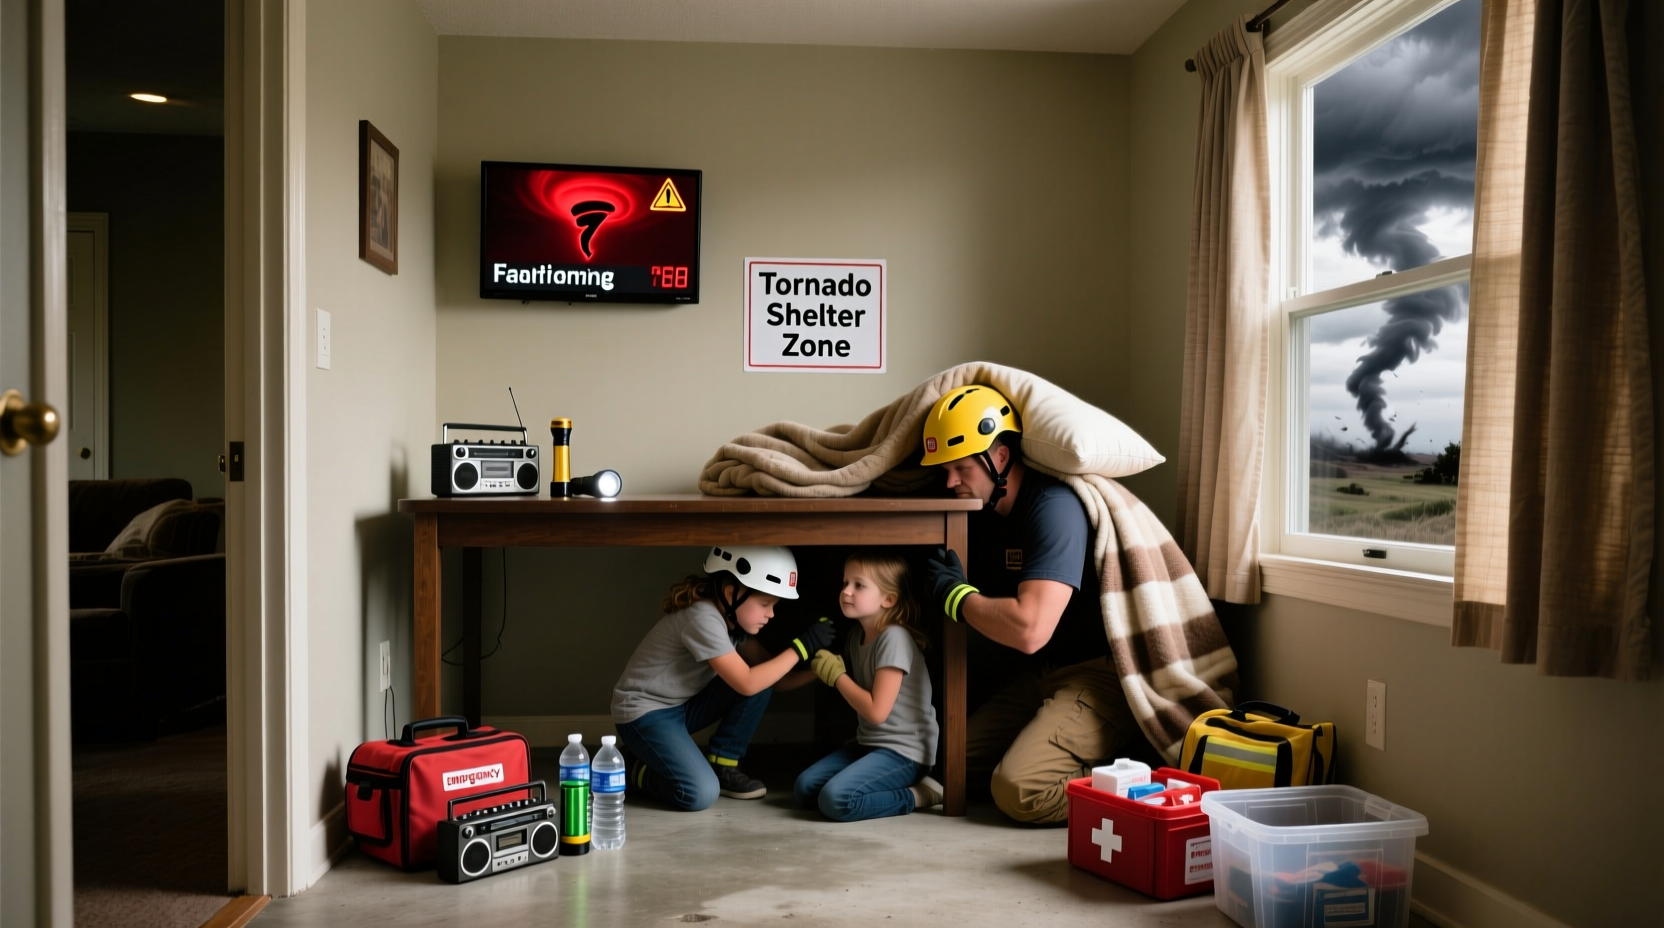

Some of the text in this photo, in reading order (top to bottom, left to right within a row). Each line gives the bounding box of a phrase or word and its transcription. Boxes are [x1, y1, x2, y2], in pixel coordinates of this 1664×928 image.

[758, 271, 872, 297] Tornado
[766, 302, 866, 327] Shelter
[781, 333, 851, 357] Zone
